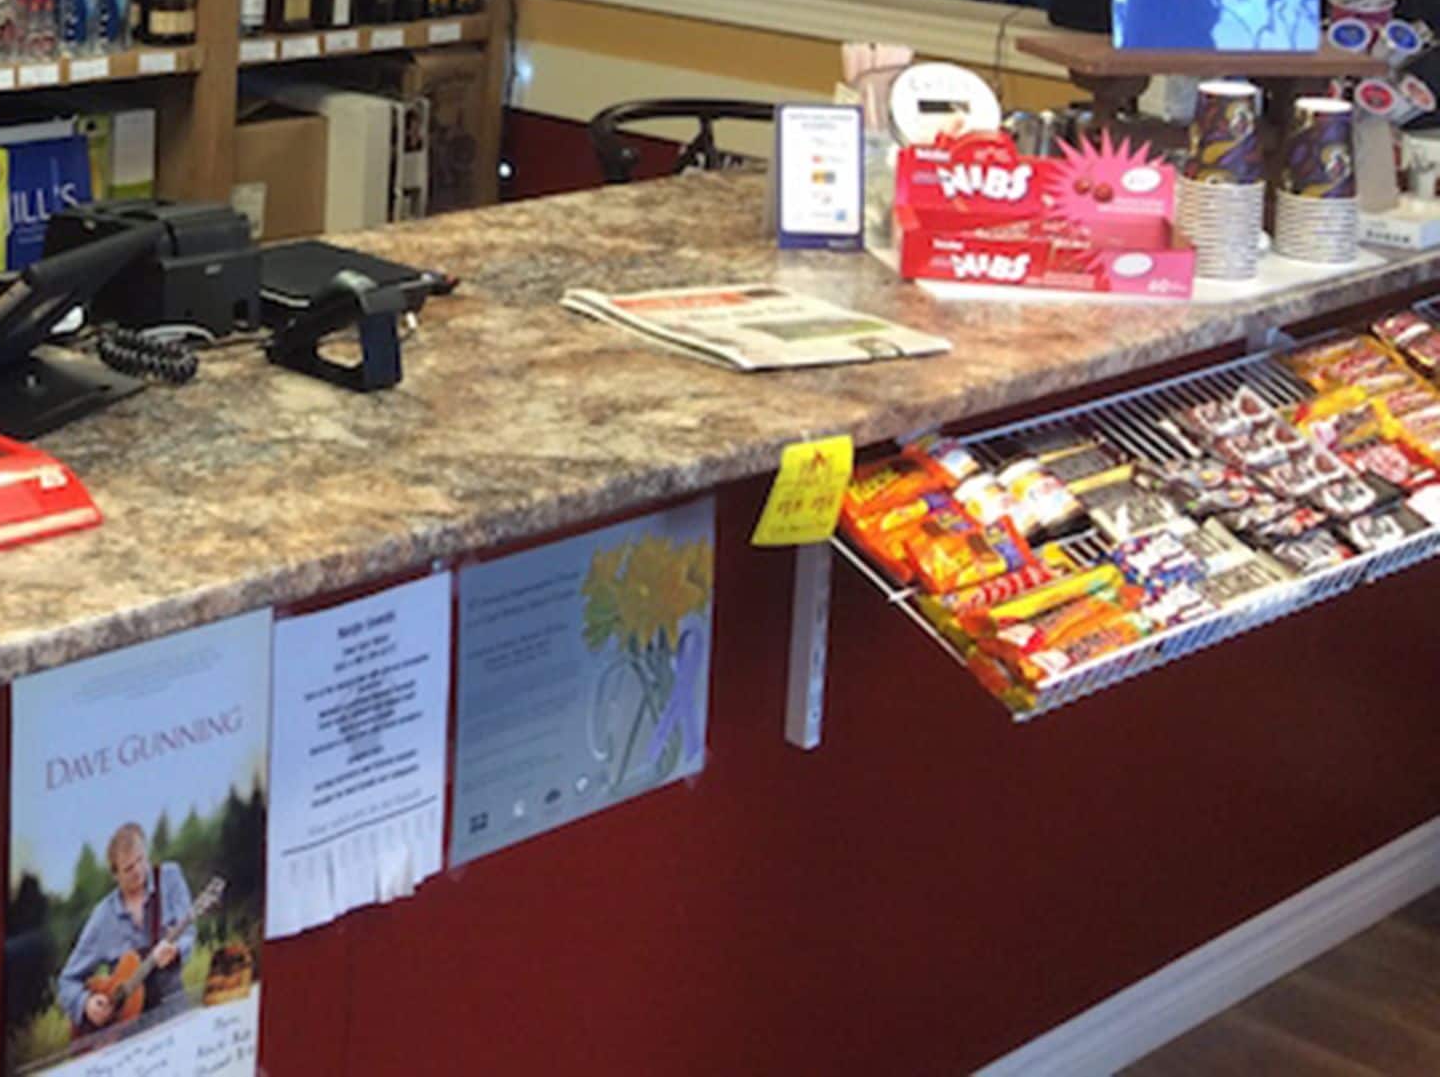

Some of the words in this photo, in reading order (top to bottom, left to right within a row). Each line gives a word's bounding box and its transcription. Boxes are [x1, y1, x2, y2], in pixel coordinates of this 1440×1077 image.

[936, 162, 1033, 202] NIBS
[950, 253, 1032, 281] NIBS
[44, 746, 113, 792] DAVE
[117, 704, 244, 767] GUNNING
